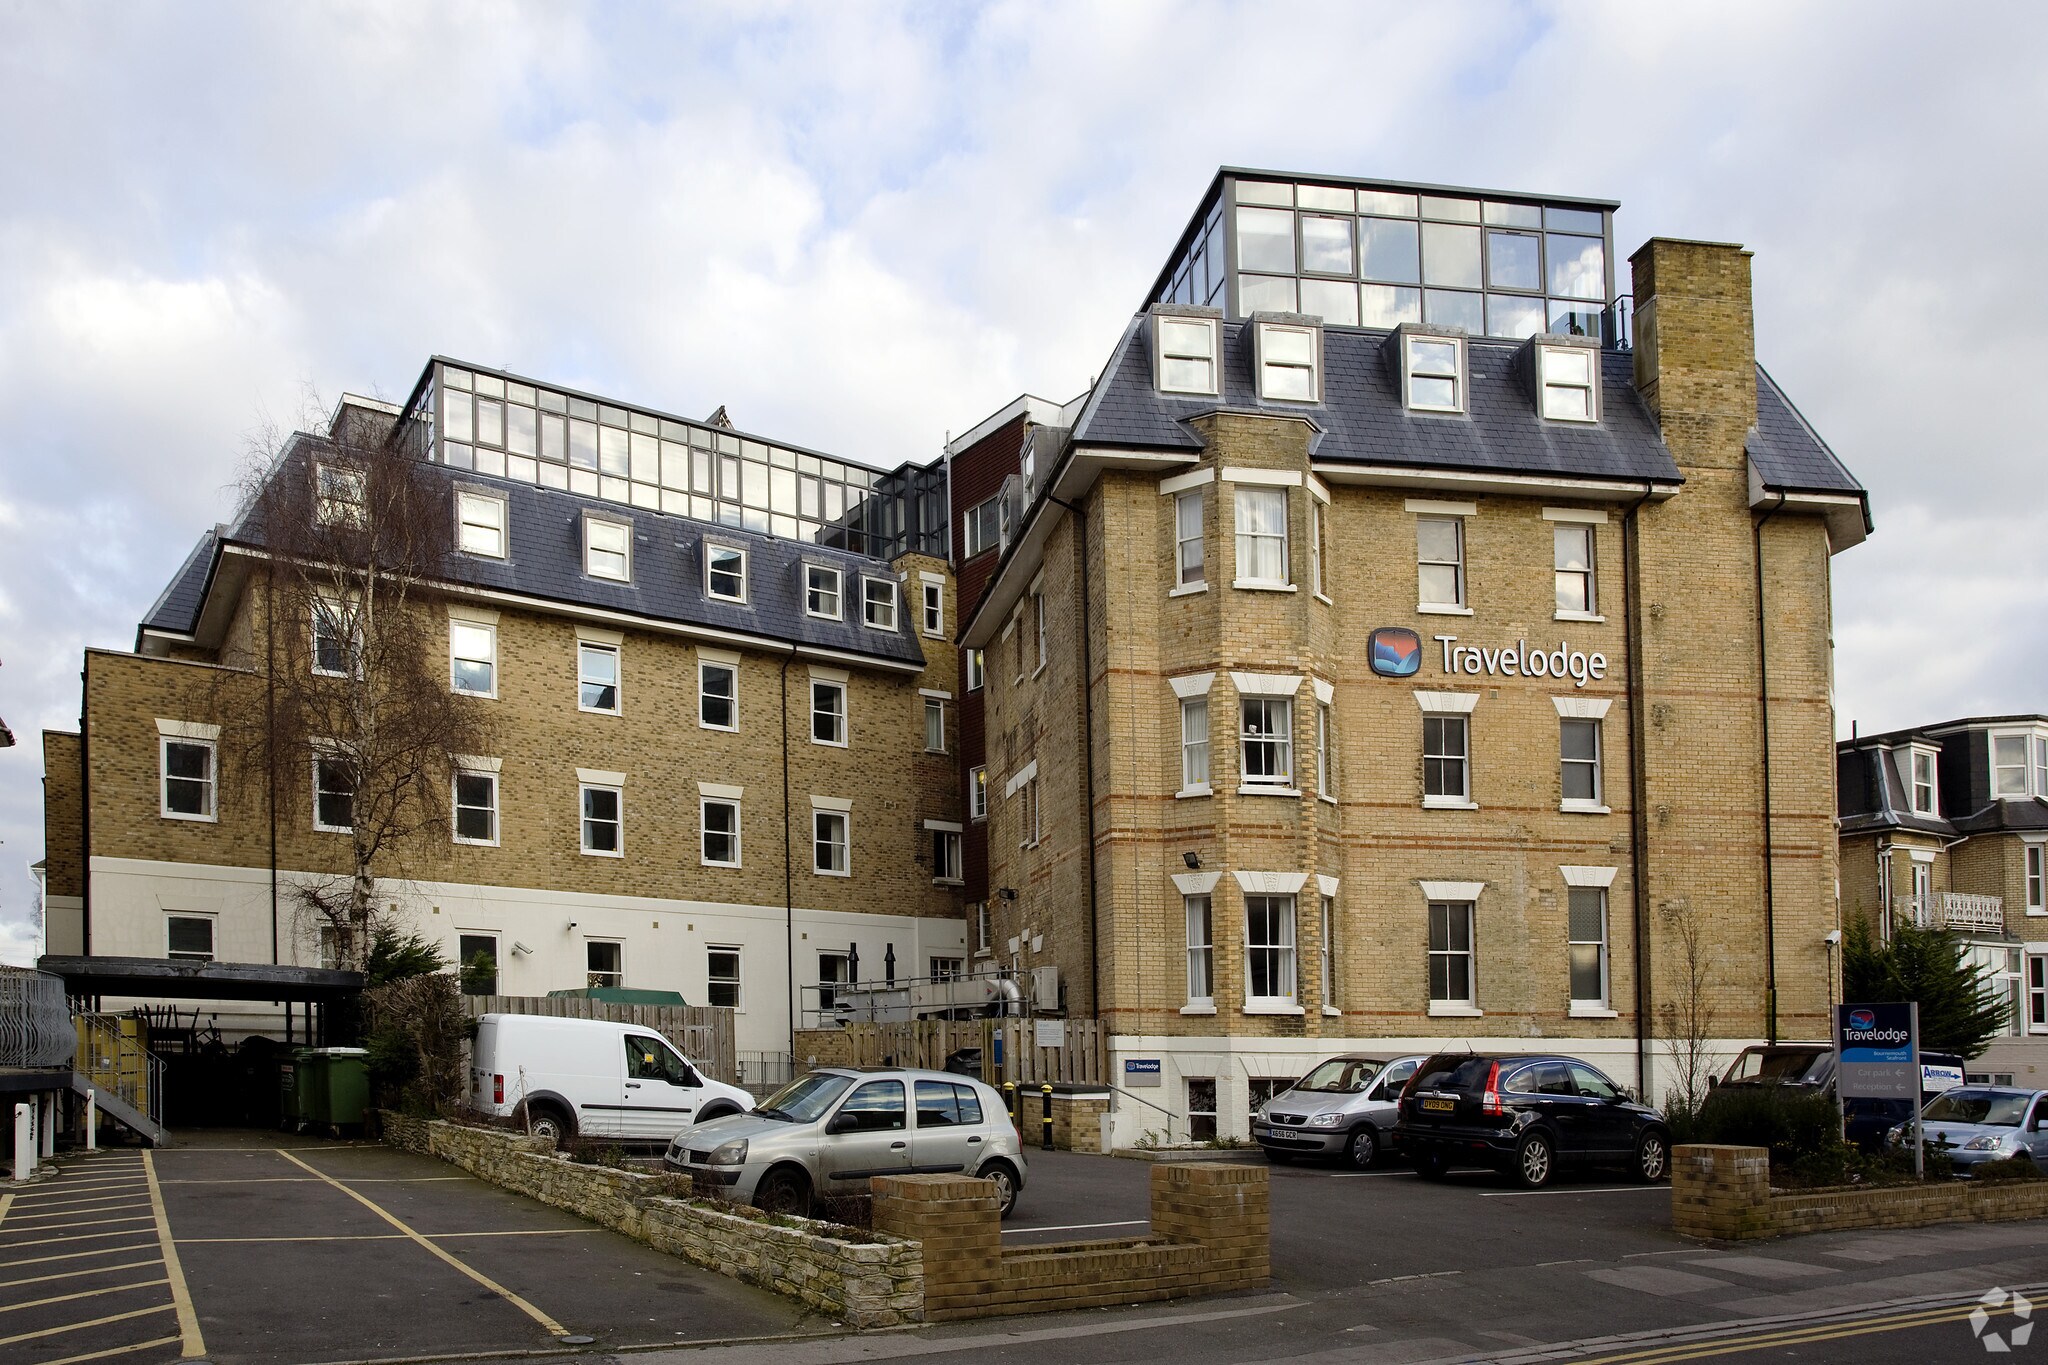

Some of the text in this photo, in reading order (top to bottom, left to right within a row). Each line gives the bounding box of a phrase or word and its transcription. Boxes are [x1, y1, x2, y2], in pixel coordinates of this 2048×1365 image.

[1434, 635, 1608, 688] Travelodge
[1843, 1028, 1908, 1043] Travelodge
[1857, 1069, 1892, 1078] Car park
[1853, 1083, 1892, 1092] Reception
